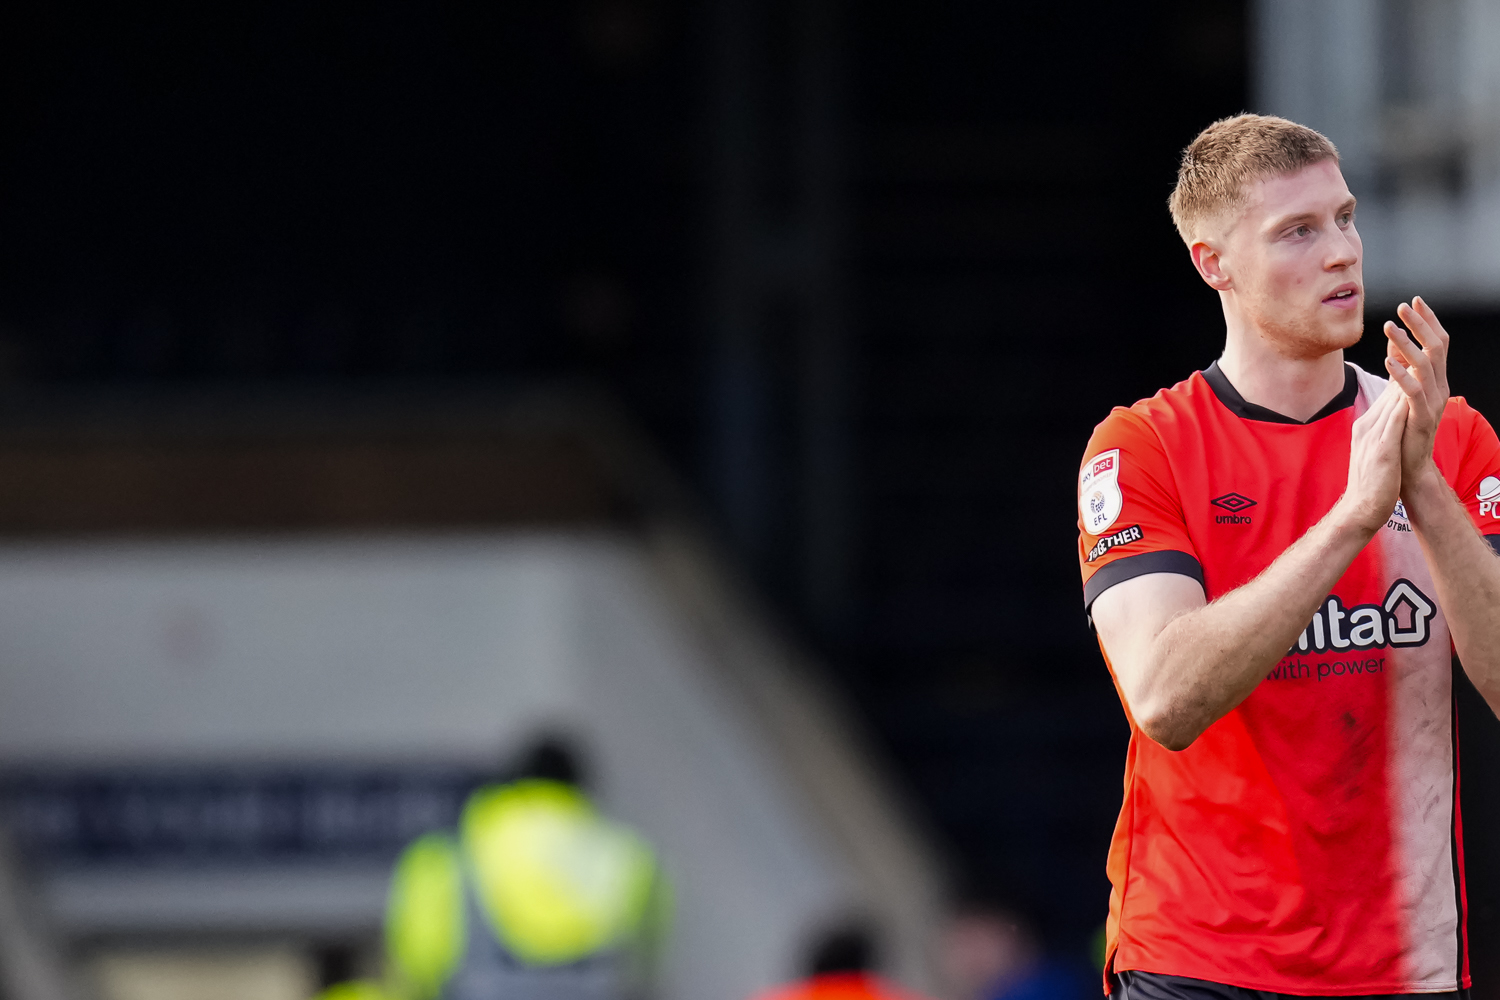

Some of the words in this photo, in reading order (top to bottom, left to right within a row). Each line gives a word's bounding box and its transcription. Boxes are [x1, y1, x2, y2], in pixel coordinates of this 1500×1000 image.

[1094, 459, 1111, 473] bet
[1094, 513, 1108, 526] EFL
[1215, 514, 1252, 524] umbro
[1317, 658, 1386, 681] power
